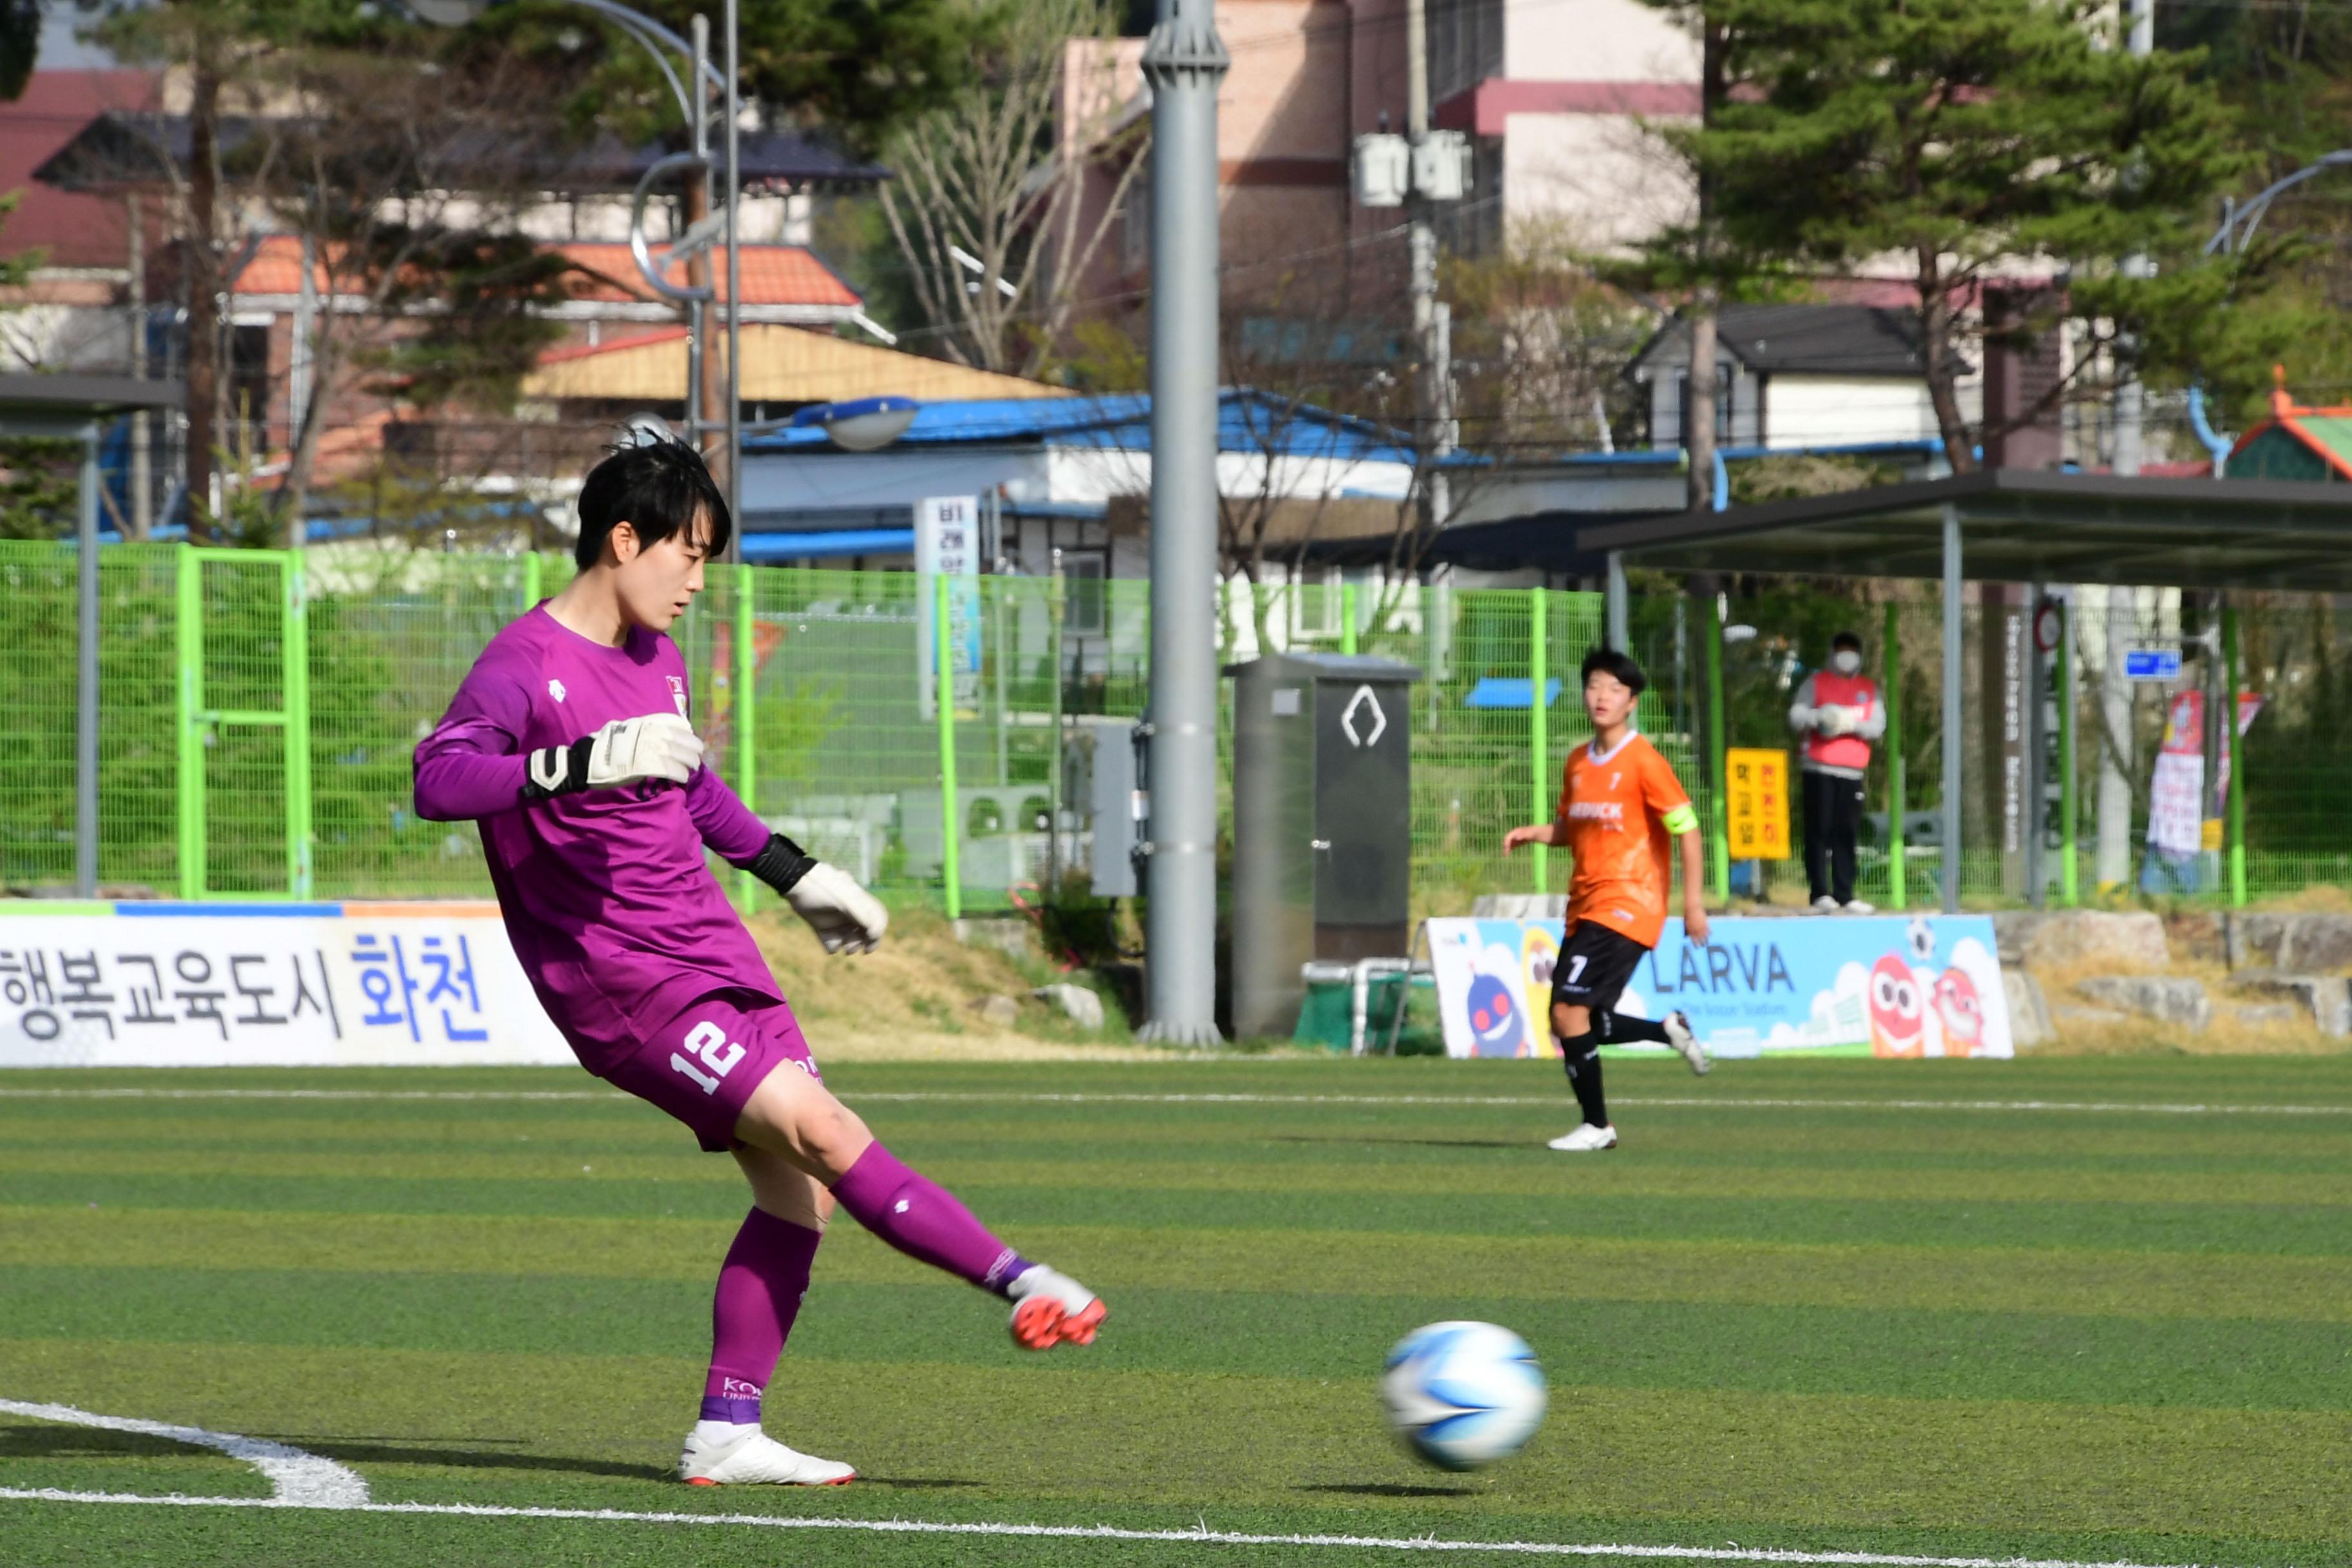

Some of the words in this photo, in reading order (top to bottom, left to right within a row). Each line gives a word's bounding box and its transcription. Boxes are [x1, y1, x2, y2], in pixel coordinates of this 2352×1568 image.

[351, 934, 487, 1042] 화천
[1567, 954, 1588, 984] 7
[1649, 943, 1794, 993] LARVA
[670, 1021, 747, 1095] 12
